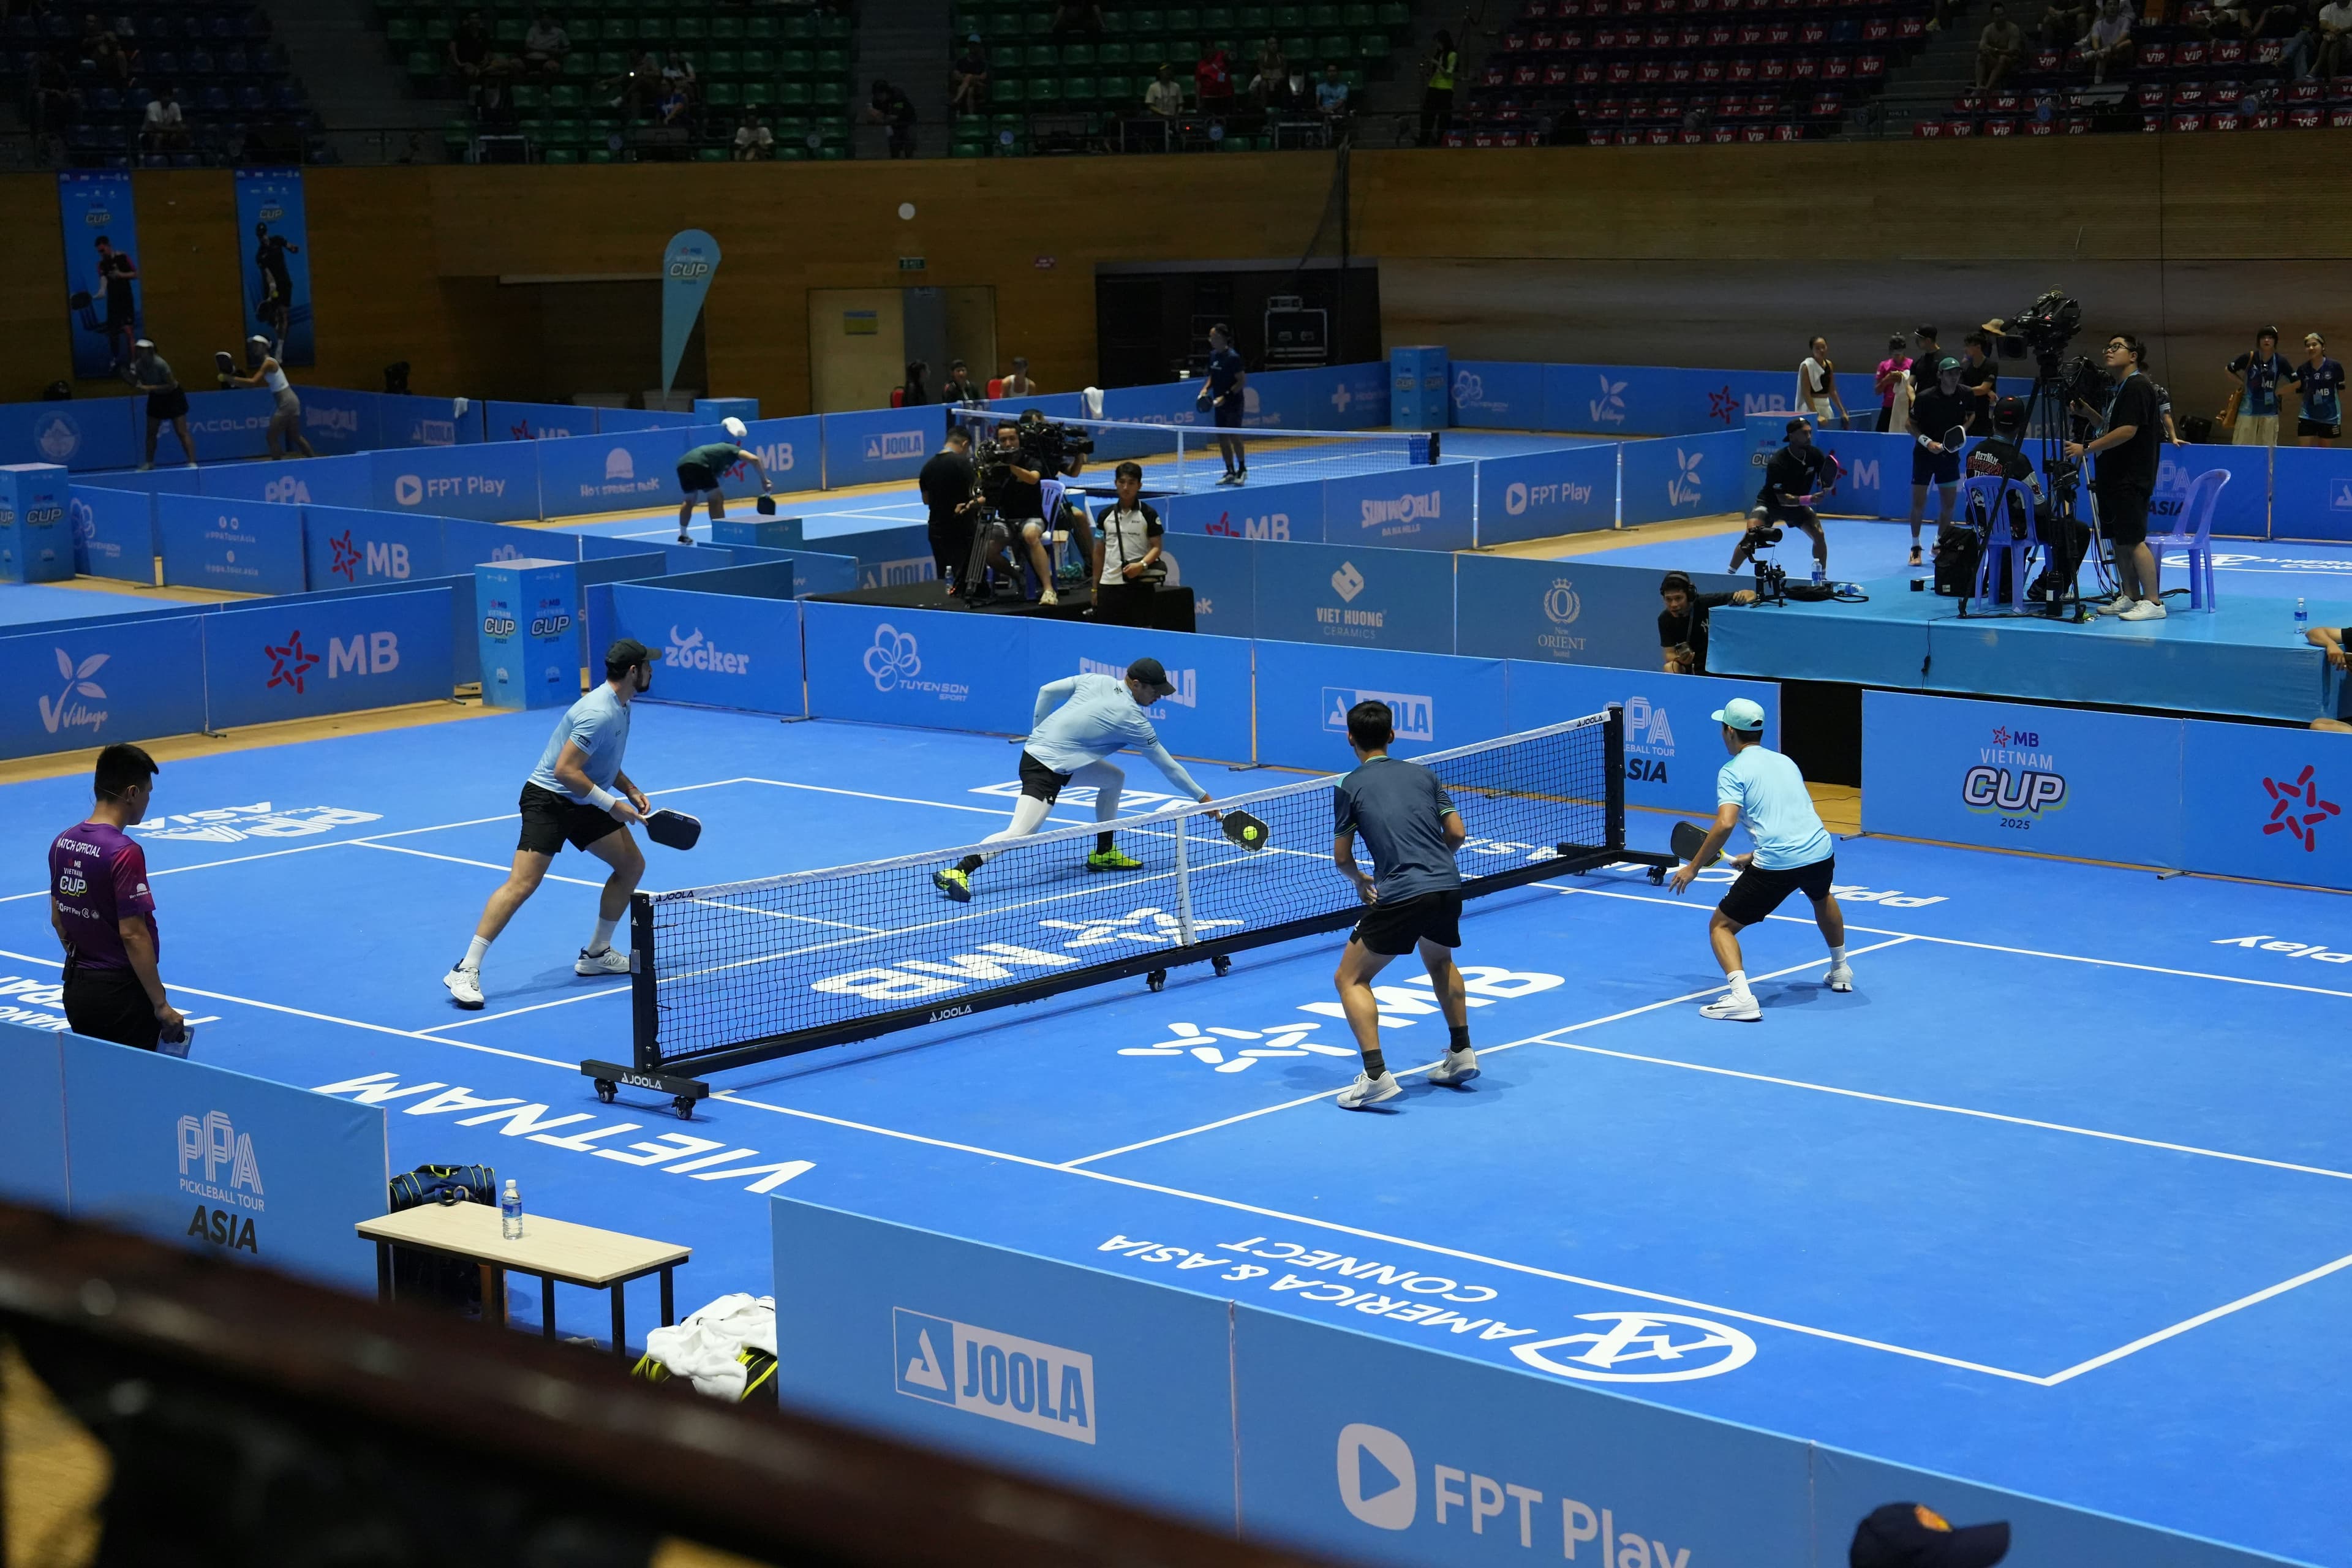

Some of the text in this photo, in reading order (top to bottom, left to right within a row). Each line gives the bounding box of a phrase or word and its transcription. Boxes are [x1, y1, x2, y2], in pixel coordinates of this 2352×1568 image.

[1564, 6, 1579, 14] VIP
[1594, 4, 1608, 12] VIP
[1627, 2, 1642, 10] VIP
[1871, 26, 1887, 36] VIP
[1904, 24, 1920, 33] VIP
[1600, 36, 1615, 45] VIP
[1626, 35, 1640, 44] VIP
[1654, 36, 1669, 44] VIP
[1684, 35, 1699, 44] VIP
[1713, 33, 1729, 42] VIP
[1744, 32, 1760, 42] VIP
[1772, 31, 1788, 40] VIP
[1806, 31, 1823, 40] VIP
[2147, 53, 2165, 62] VIP
[2184, 50, 2202, 61] VIP
[2222, 48, 2241, 58] VIP
[1863, 61, 1879, 71] VIP
[2038, 56, 2056, 66] VIP
[1615, 69, 1630, 78] VIP
[1645, 69, 1660, 78] VIP
[1673, 70, 1689, 79] VIP
[1703, 67, 1719, 77] VIP
[1736, 67, 1751, 77] VIP
[1767, 66, 1782, 75] VIP
[1796, 65, 1813, 75] VIP
[1830, 65, 1846, 74] VIP
[1520, 72, 1535, 81] VIP
[1551, 72, 1566, 80] VIP
[2298, 86, 2318, 96] VIP
[1999, 98, 2015, 107] VIP
[1820, 104, 1836, 112] VIP
[2180, 121, 2199, 130] VIP
[2218, 119, 2237, 129] VIP
[1922, 127, 1939, 136] VIP
[1954, 126, 1970, 135] VIP
[1992, 127, 2010, 135] VIP
[2032, 126, 2050, 135] VIP
[1653, 135, 1668, 144] VIP
[1684, 135, 1700, 143] VIP
[1716, 132, 1732, 143] VIP
[1747, 132, 1765, 141] VIP
[670, 262, 709, 277] CUP
[886, 435, 921, 454] JOOLA
[756, 443, 794, 472] MB
[1975, 451, 1999, 466] VIETNAM
[2155, 459, 2192, 492] PA
[265, 475, 312, 503] PPA
[428, 475, 506, 498] FPT Play
[1531, 481, 1592, 505] FPT Play
[0, 509, 15, 525] UP
[26, 507, 63, 526] CUP
[1245, 514, 1289, 540] MB
[368, 541, 410, 579] MB
[1316, 608, 1383, 627] VIET HUONG
[483, 616, 516, 636] CUP
[530, 614, 570, 636] CUP
[1324, 625, 1376, 639] CERAMICS
[1555, 626, 1569, 636] New
[1538, 635, 1586, 650] ORIENT
[328, 632, 400, 679] MB
[665, 641, 750, 674] zocker
[1553, 649, 1570, 658] hotel
[899, 679, 969, 695] TUYENSON
[938, 693, 968, 702] SPORT
[62, 701, 108, 732] Village
[1582, 715, 1603, 725] JOOLA
[1603, 696, 1675, 747] PA
[2013, 731, 2040, 748] MB
[1652, 746, 1675, 757] TOUR
[1980, 747, 2053, 771] VIETNAM
[1624, 758, 1667, 784] SIA
[1962, 765, 2066, 813] CUP
[2000, 817, 2031, 830] 2025
[56, 837, 101, 858] MATCH OFFICIAL
[74, 859, 81, 868] MB
[64, 867, 83, 878] VIETNAM
[59, 875, 87, 894] CUP
[665, 889, 695, 901] JOOLA
[72, 907, 81, 917] Play
[1295, 965, 1566, 1029] MB
[937, 1005, 973, 1021] JOOLA
[629, 1074, 663, 1090] JOOLA
[309, 1072, 817, 1194] VIETNAM
[177, 1109, 264, 1196] PPA
[179, 1178, 265, 1213] PICKLEBALL TOUR
[187, 1205, 258, 1254] ASIA
[1216, 1237, 1499, 1302] CONNECT
[1097, 1234, 1539, 1341] AMERICA & ASIA
[963, 1340, 1088, 1428] JOOLA
[1434, 1463, 1692, 1568] FPT Play
